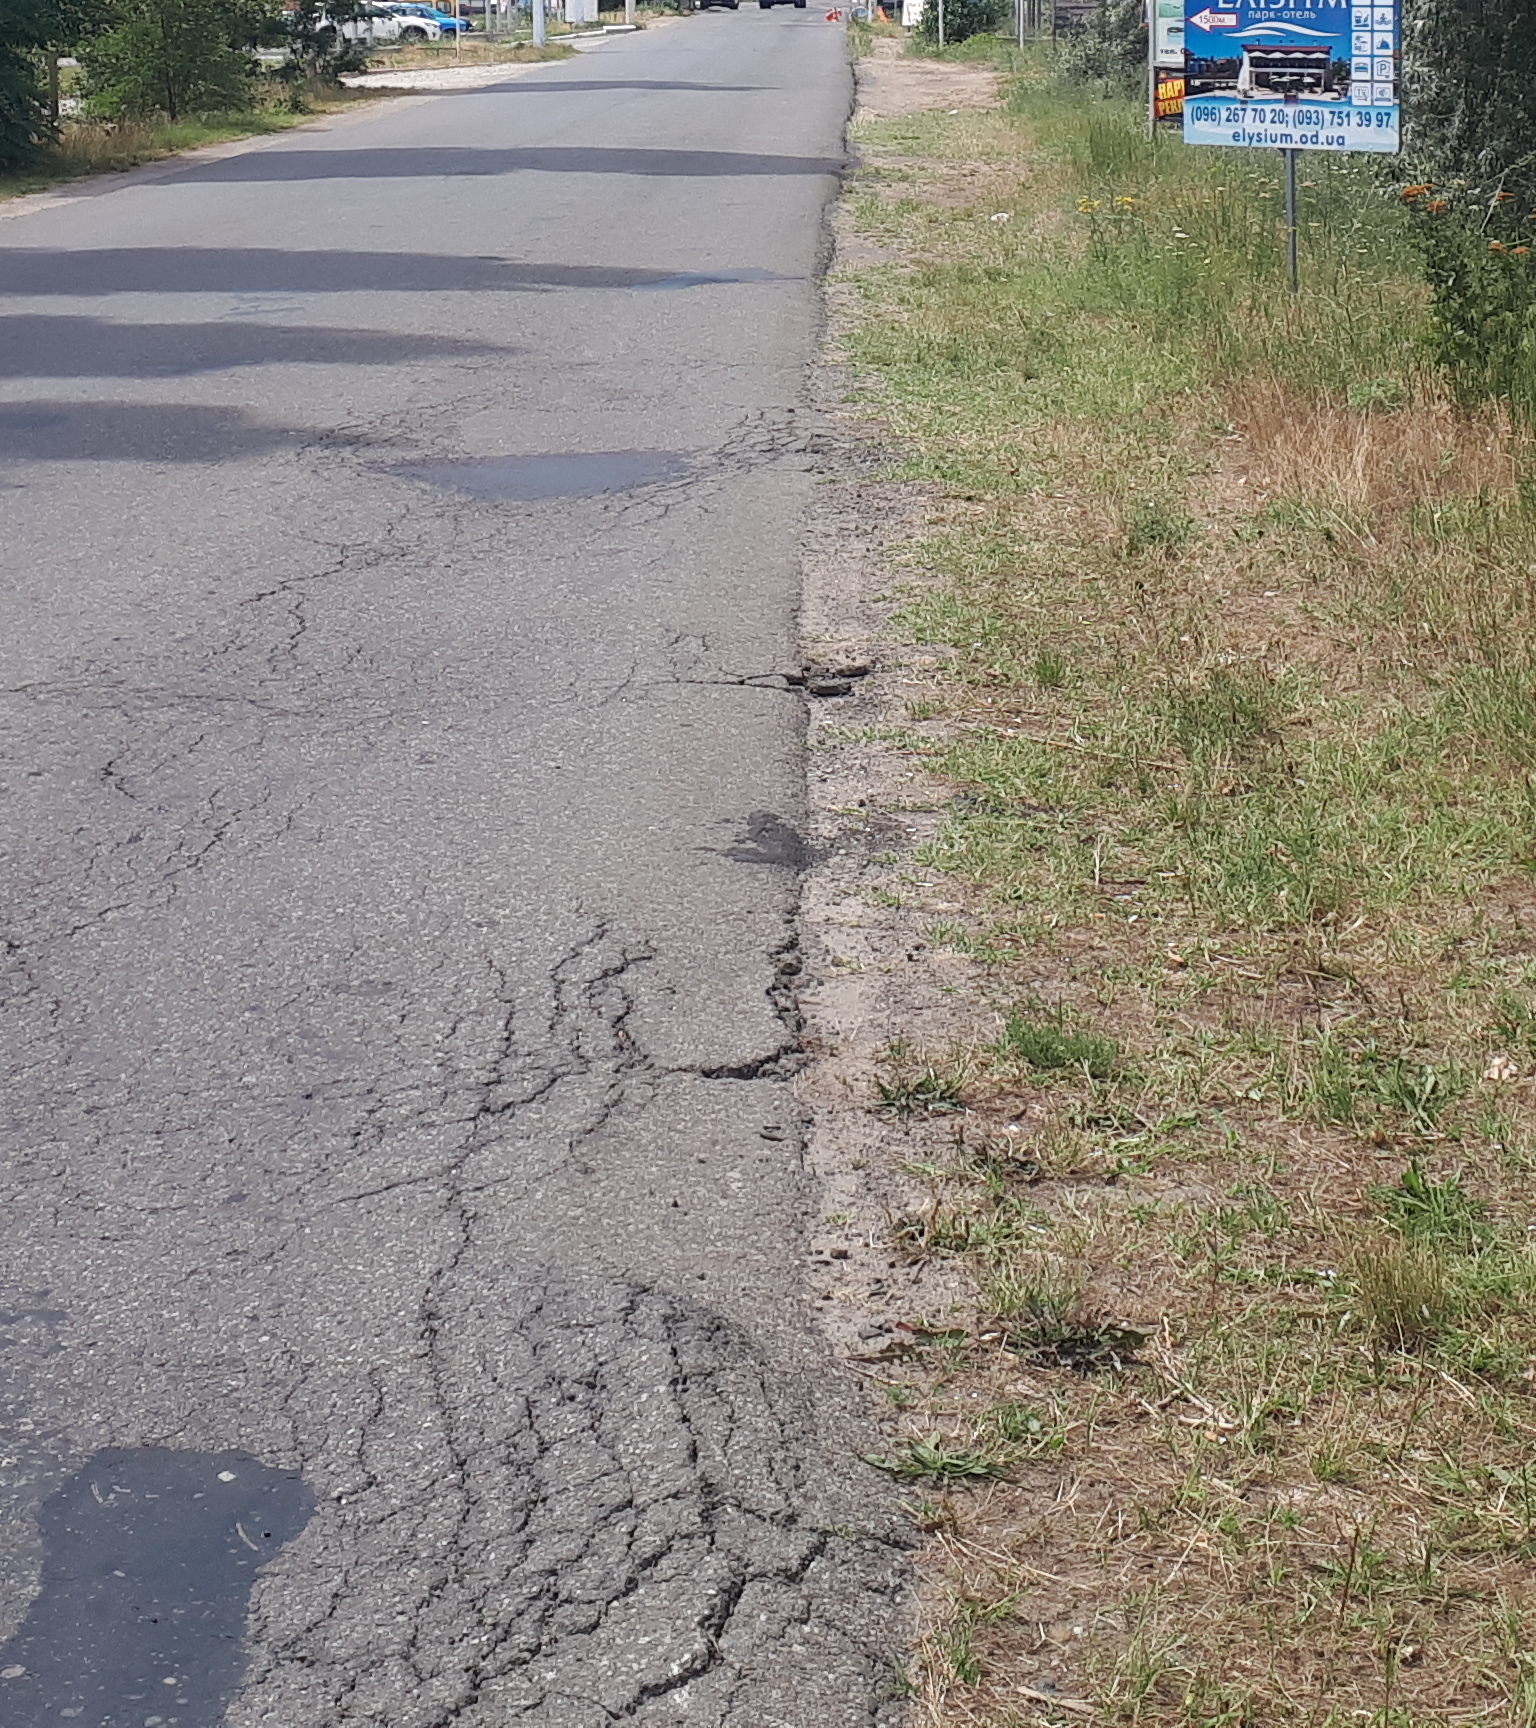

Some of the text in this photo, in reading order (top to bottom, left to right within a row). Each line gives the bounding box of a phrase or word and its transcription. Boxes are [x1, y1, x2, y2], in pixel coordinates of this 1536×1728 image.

[1190, 106, 1221, 126] (096)
[1225, 107, 1247, 124] 267
[1252, 108, 1265, 124] 70
[1292, 109, 1325, 130] (093)
[1329, 110, 1351, 127] 751
[1356, 111, 1372, 128] 39
[1375, 112, 1392, 128] 97
[1232, 129, 1346, 147] elysium.od.ua
